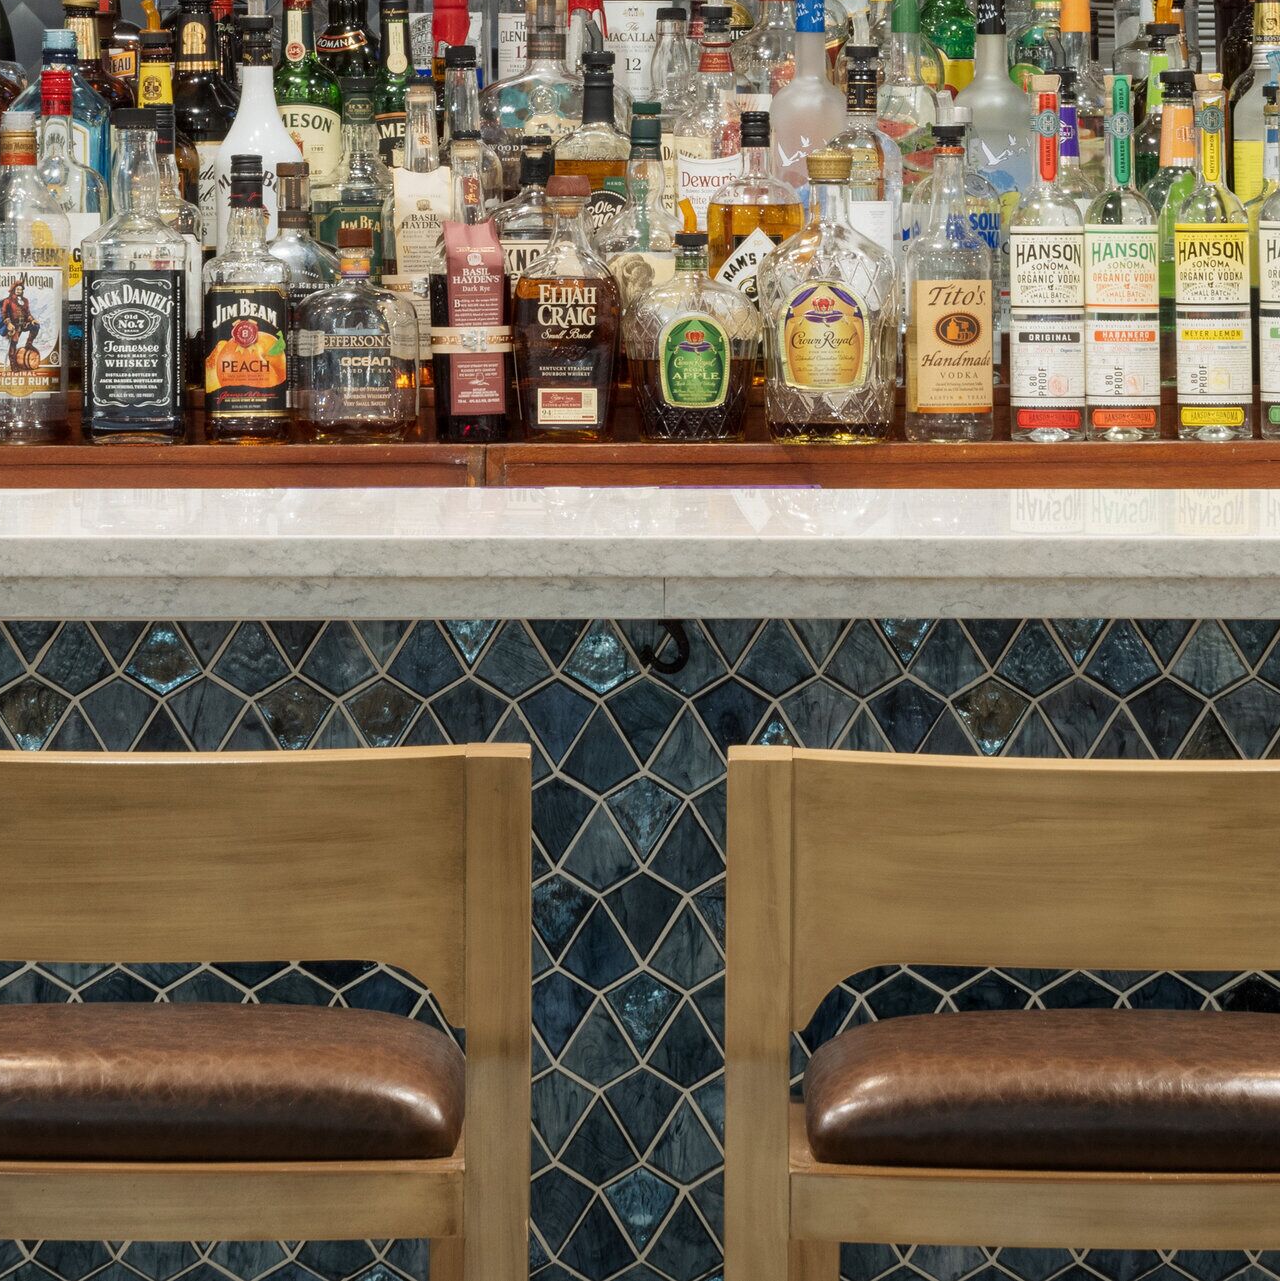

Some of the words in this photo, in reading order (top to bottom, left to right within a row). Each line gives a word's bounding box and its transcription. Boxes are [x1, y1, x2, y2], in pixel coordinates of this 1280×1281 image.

[515, 21, 527, 29] TH
[626, 23, 641, 32] The
[500, 30, 528, 44] GLENL
[604, 32, 656, 42] MACALLA
[624, 58, 642, 71] 12
[282, 113, 332, 132] MESON
[682, 171, 737, 188] Dewar's
[594, 200, 613, 214] Ole
[411, 214, 439, 222] BASIL
[1016, 244, 1081, 268] HANSON
[1092, 242, 1156, 266] HANSON
[1178, 241, 1244, 266] HANSON
[722, 252, 757, 282] RAM'S
[1032, 262, 1070, 270] SONOMA
[1107, 262, 1145, 270] SONOMA
[1192, 260, 1230, 268] SONOMA
[462, 268, 490, 277] BASIL
[1017, 274, 1054, 284] ORGANIC
[1057, 274, 1080, 284] VODKA
[1092, 273, 1130, 282] ORGANIC
[1134, 273, 1156, 282] VODKA
[1179, 272, 1214, 282] ORGANIC
[1218, 271, 1244, 282] VODKA
[18, 272, 54, 290] Morgan
[452, 275, 500, 284] HAYDEN'S
[90, 290, 122, 316] JACK
[122, 284, 174, 316] DANIEL'S
[538, 284, 597, 308] ELIJAH
[928, 284, 986, 306] Tito's
[212, 304, 239, 329] JIM
[239, 298, 278, 327] BEAM
[538, 305, 596, 328] CRAIG
[118, 320, 144, 329] No.7
[540, 328, 566, 340] Small
[568, 328, 594, 340] Batch
[791, 330, 822, 350] Crown
[822, 330, 858, 350] Royal
[1102, 331, 1150, 339] HABANERO
[104, 340, 160, 353] Tennessee
[324, 335, 392, 348] EFFERSON'S
[104, 360, 159, 368] WHISKEY
[340, 356, 392, 367] OCEAN
[921, 350, 991, 368] Handmade
[222, 360, 270, 372] PEACH
[28, 376, 50, 386] RUM
[672, 372, 720, 380] APPLE
[1038, 367, 1047, 397] PROOF
[1114, 365, 1123, 396] PROOF
[1198, 364, 1208, 394] PROOF
